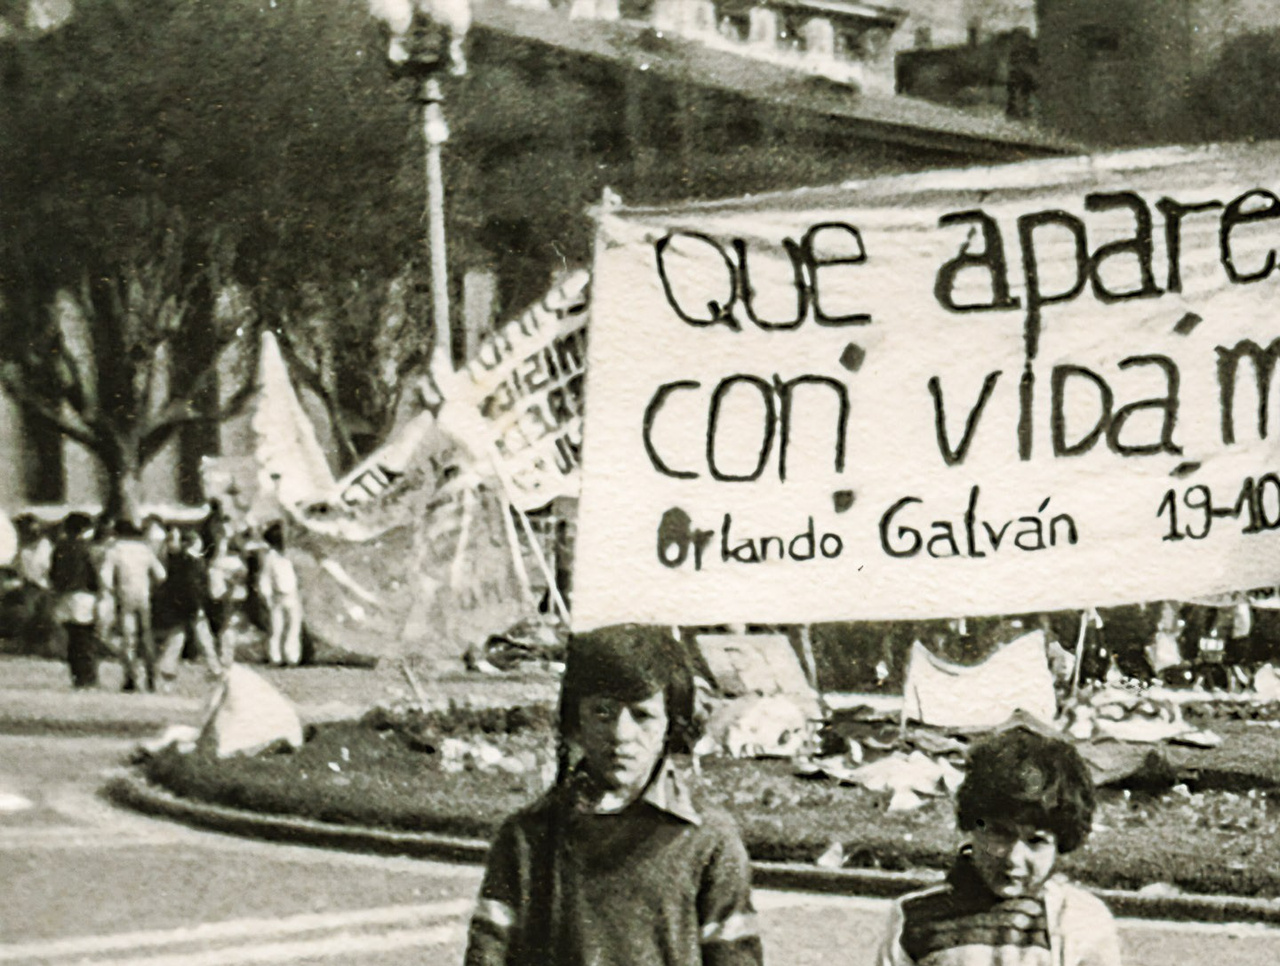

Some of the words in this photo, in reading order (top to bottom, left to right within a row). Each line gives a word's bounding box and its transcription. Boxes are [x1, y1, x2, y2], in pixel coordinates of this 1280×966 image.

[642, 372, 851, 484] con
[656, 506, 844, 571] Orlando
[878, 485, 1080, 559] Galván
